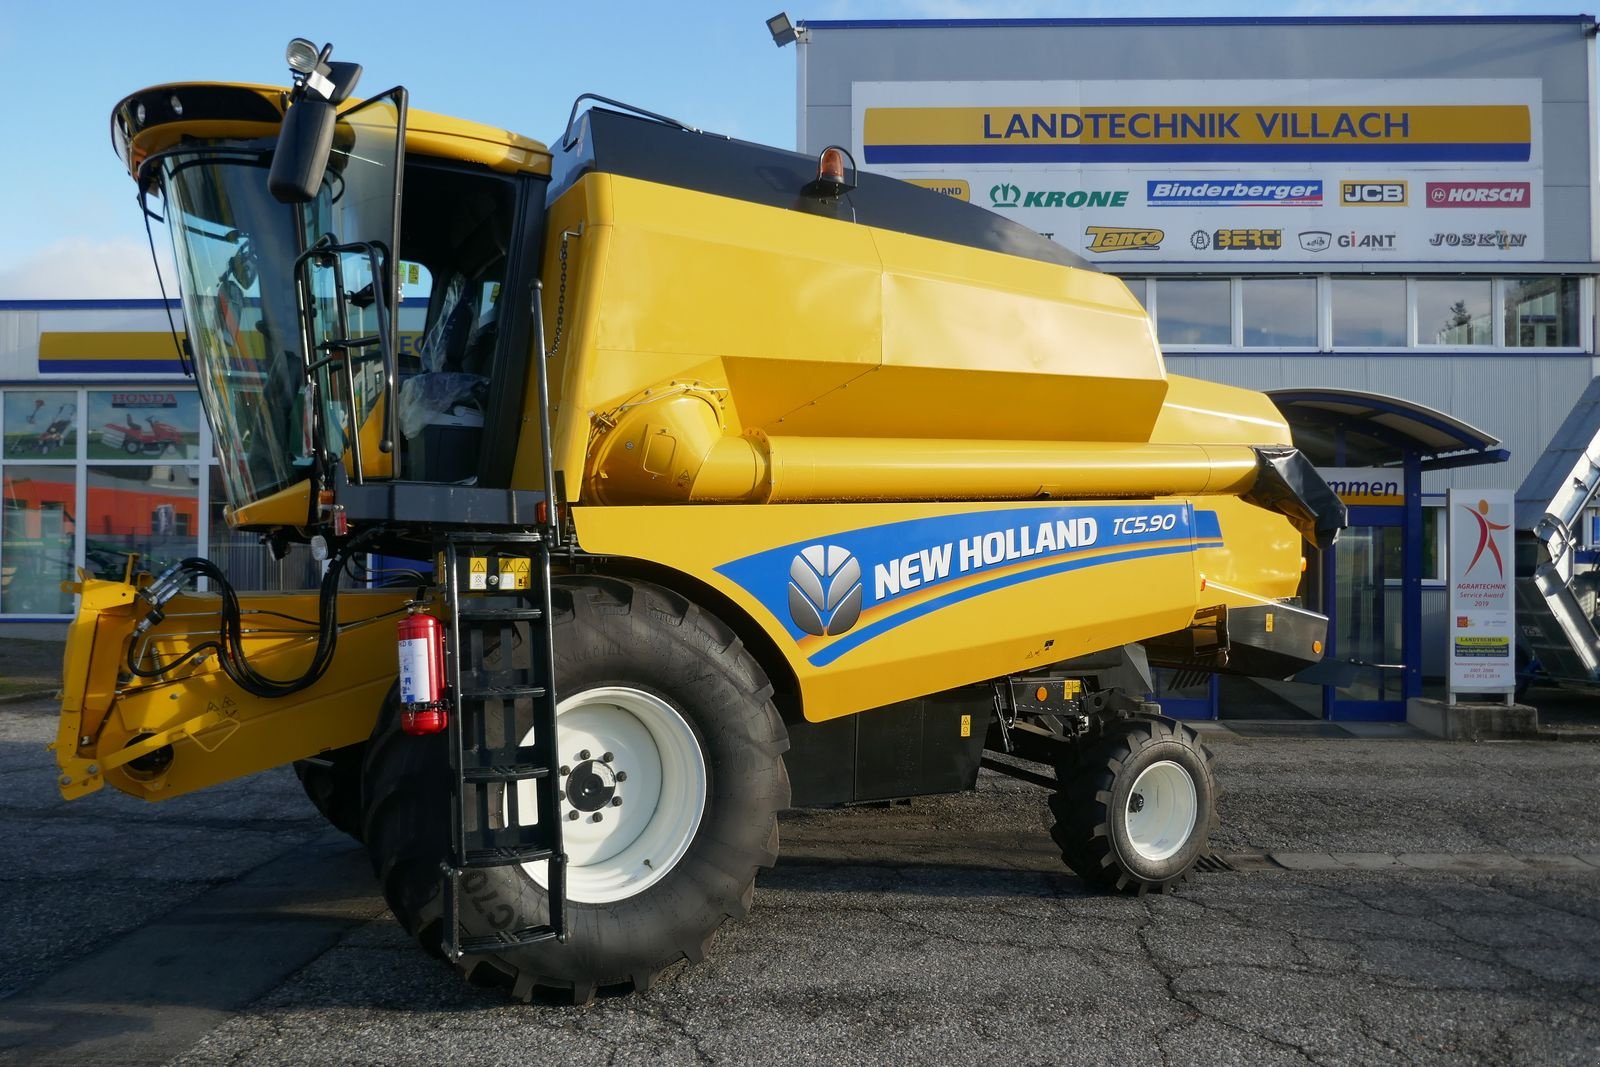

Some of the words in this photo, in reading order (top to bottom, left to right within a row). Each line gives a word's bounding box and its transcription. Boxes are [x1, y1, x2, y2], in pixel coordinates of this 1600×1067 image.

[984, 112, 1240, 140] LANDTECHNIK
[1256, 111, 1409, 139] VILLACH
[1023, 191, 1129, 208] KRONE
[1152, 182, 1319, 201] Binderberger
[1344, 183, 1404, 202] JCB
[1448, 188, 1525, 203] HORSCH
[1086, 226, 1165, 254] Tanco
[1428, 230, 1528, 250] JOSKIN
[112, 393, 177, 404] HONDA
[1111, 512, 1178, 537] TC5.90
[873, 542, 953, 602] NEW
[958, 516, 1099, 573] HOLLAND
